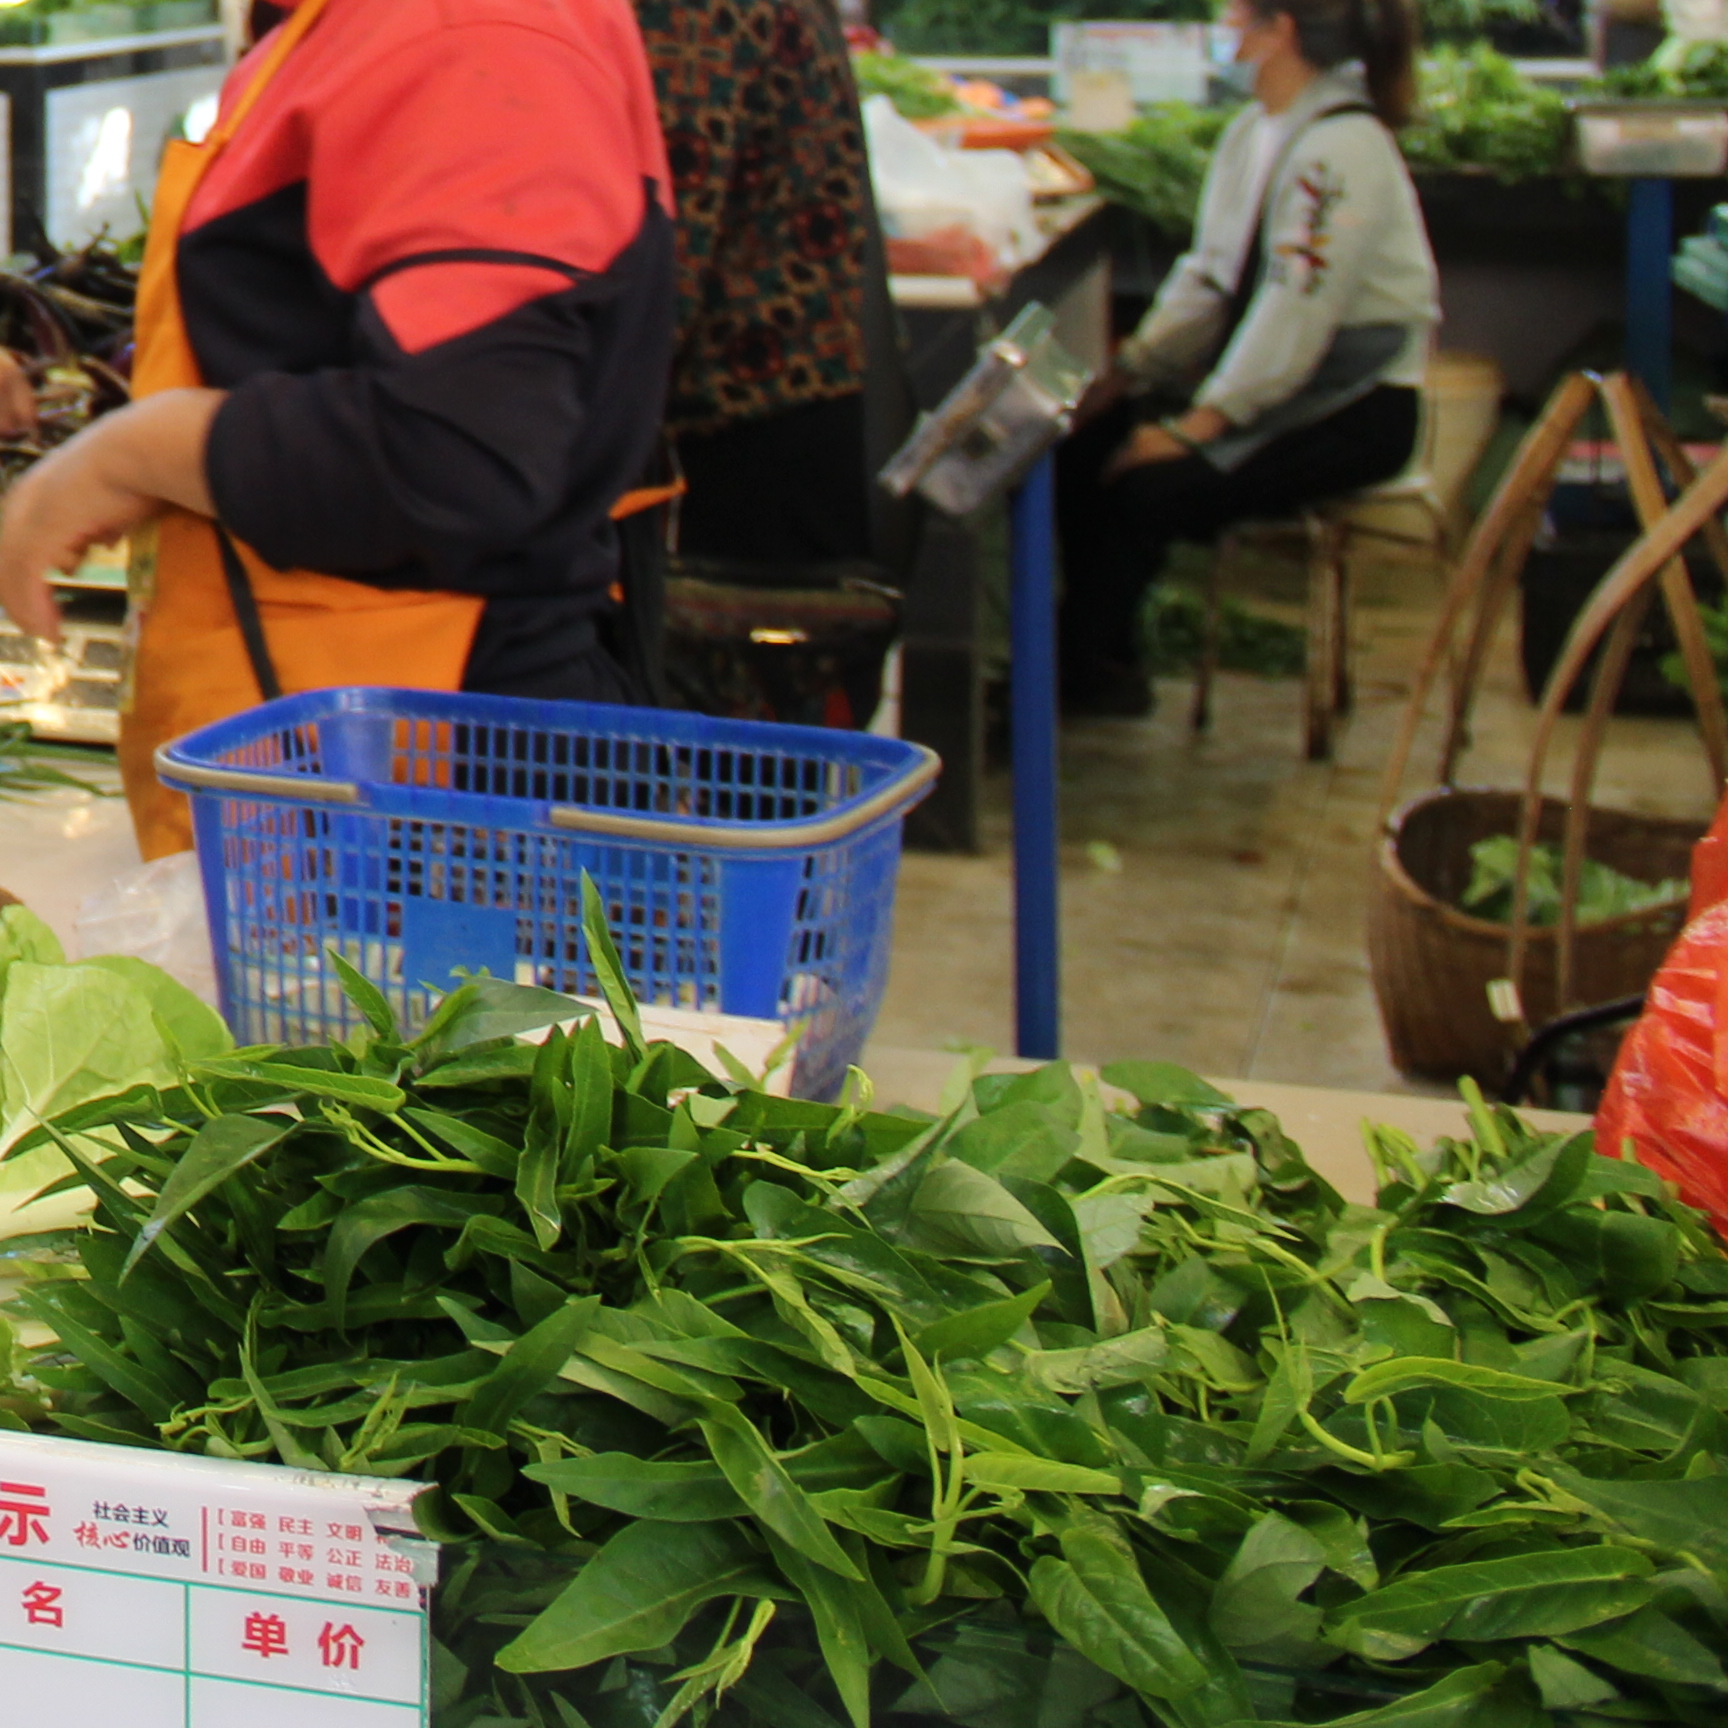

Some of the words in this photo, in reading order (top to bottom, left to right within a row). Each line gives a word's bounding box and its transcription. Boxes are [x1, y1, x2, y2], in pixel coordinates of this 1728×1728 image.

[93, 1500, 170, 1529] 社会主义
[231, 1510, 267, 1531] 富强
[278, 1516, 314, 1536] 民主
[326, 1523, 363, 1542] 文明
[73, 1521, 191, 1559] 核心价值观
[231, 1535, 266, 1555] 自由
[278, 1541, 314, 1561] 平等
[326, 1547, 363, 1567] 公正
[374, 1553, 414, 1575] 法治
[374, 1578, 411, 1598] 友善
[241, 1611, 365, 1671] 单价
